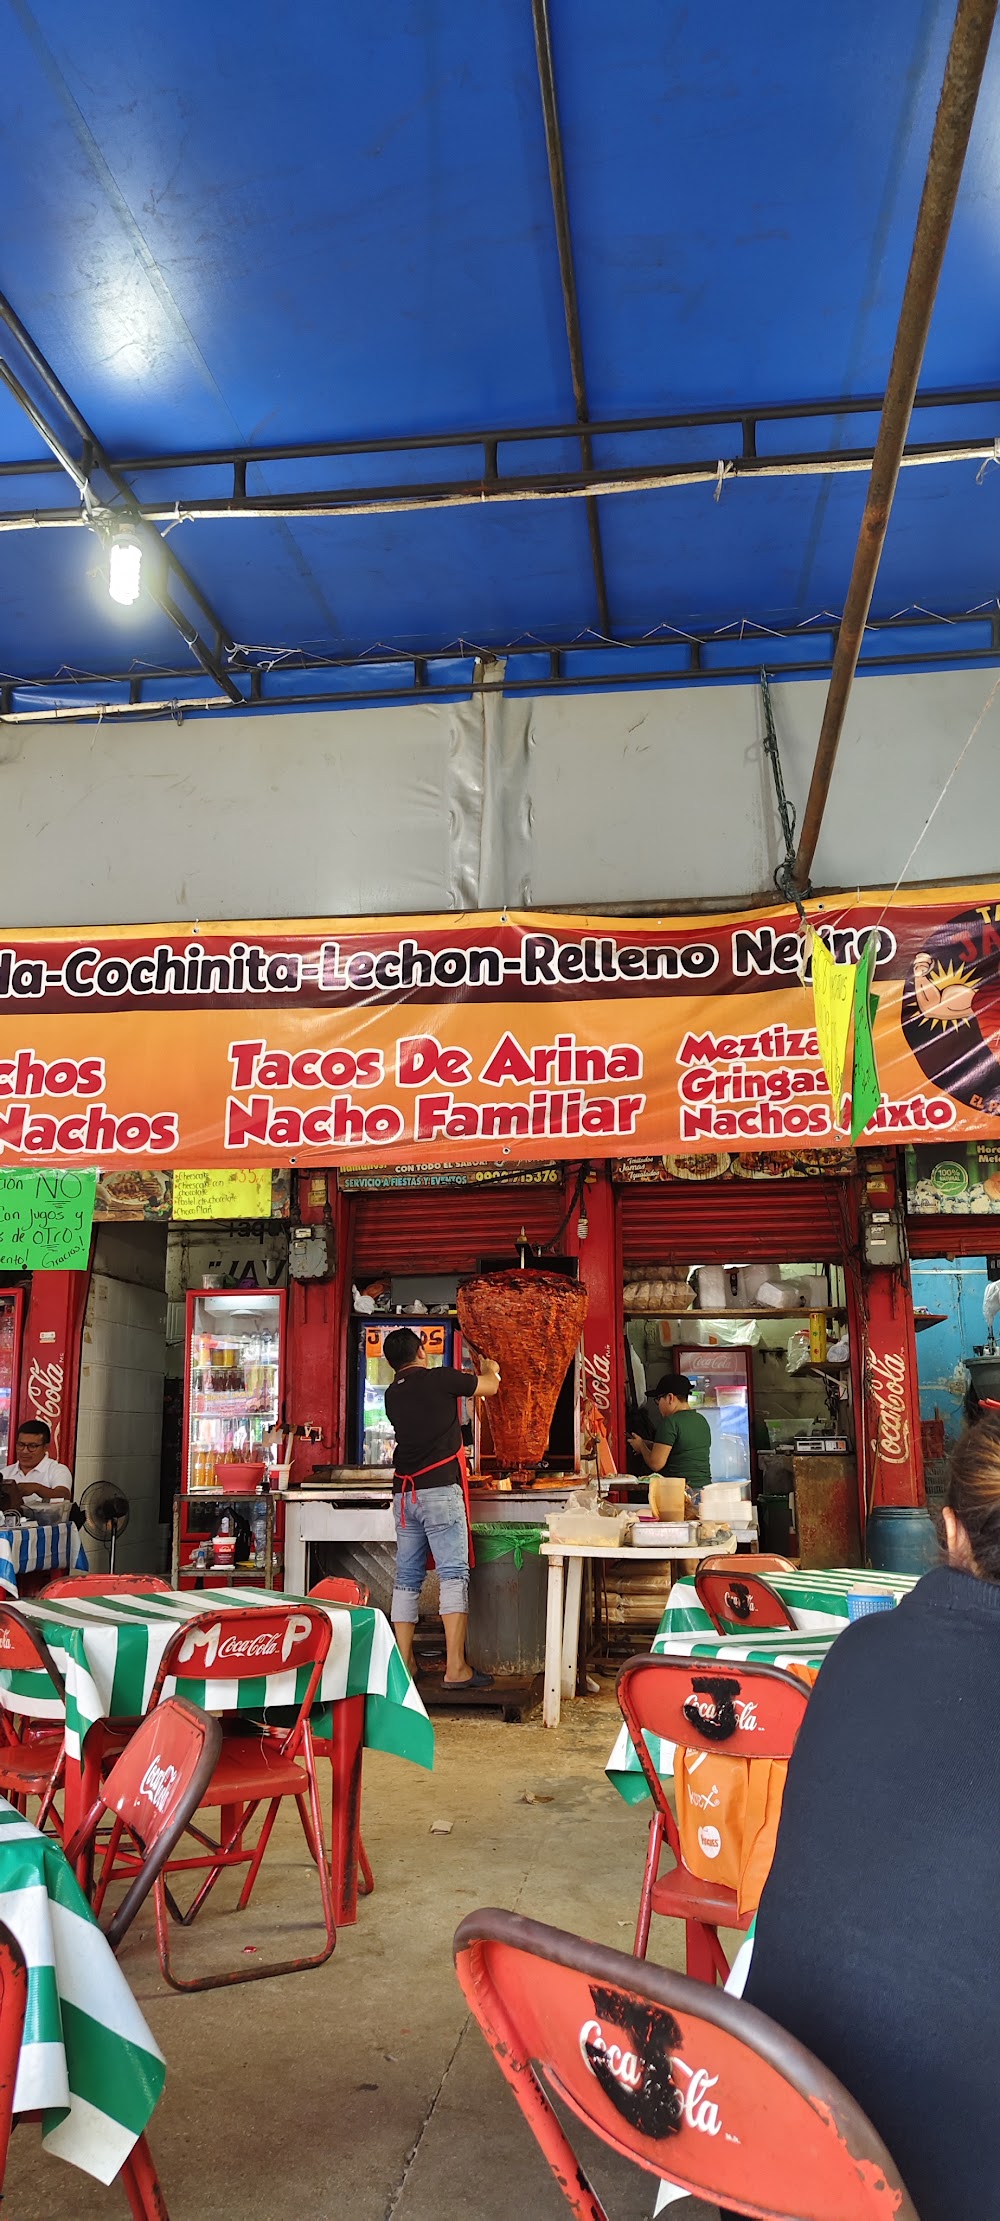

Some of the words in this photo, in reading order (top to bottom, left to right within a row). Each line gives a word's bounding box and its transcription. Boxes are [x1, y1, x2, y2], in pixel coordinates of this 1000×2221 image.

[230, 1040, 384, 1089] Tacos
[396, 1036, 472, 1087] De
[480, 1032, 642, 1086] Arina
[226, 1095, 403, 1148] Nacho
[415, 1090, 646, 1141] Familiar
[681, 1101, 830, 1139] Nachos
[395, 1165, 415, 1173] CON
[415, 1162, 441, 1171] TODO
[978, 1154, 1000, 1163] Mel
[36, 1172, 82, 1199] NO
[344, 1178, 381, 1188] SERVICIO
[391, 1175, 421, 1186] FIESTAS
[74, 1211, 83, 1231] y
[12, 1227, 25, 1243] de
[178, 1622, 222, 1668] M
[282, 1613, 312, 1663] P
